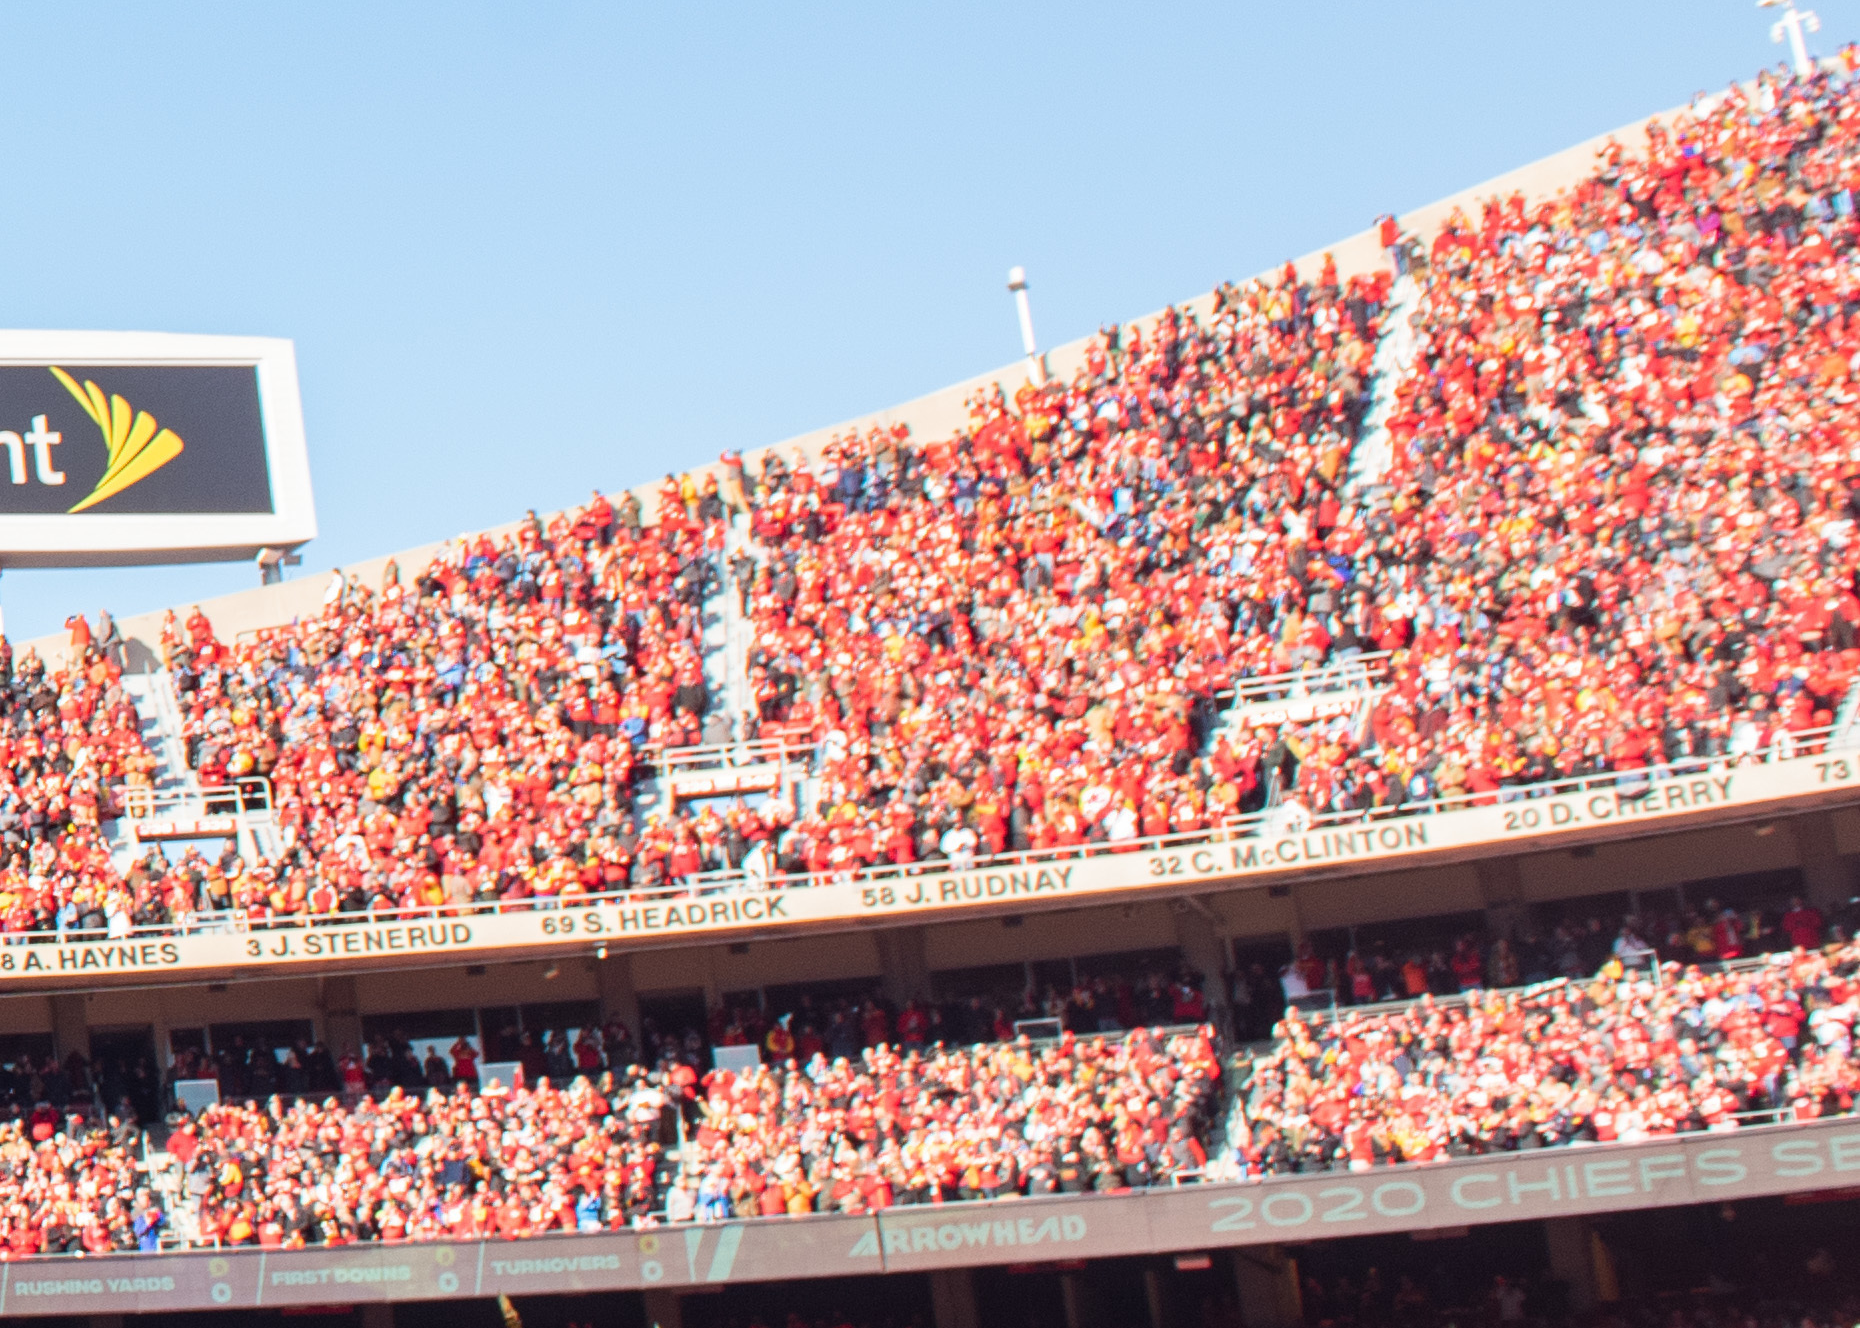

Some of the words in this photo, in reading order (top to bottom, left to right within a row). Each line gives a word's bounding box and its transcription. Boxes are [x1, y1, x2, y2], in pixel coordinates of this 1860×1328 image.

[1815, 760, 1849, 783] 73
[1504, 807, 1542, 831] 20
[1550, 799, 1583, 827] D.
[1587, 777, 1735, 822] CHERRY
[1150, 856, 1185, 876] 32
[1191, 849, 1223, 875] C.
[1231, 822, 1428, 869] McCLINTON
[863, 887, 896, 908] 58
[905, 880, 932, 904] J.
[940, 866, 1073, 902] RUDNAY
[541, 915, 576, 935] 69
[583, 910, 612, 934] S.
[620, 895, 788, 933] HEADRICK
[247, 939, 262, 957] 3
[269, 935, 295, 957] J.
[304, 923, 473, 956] STENERUD
[21, 949, 51, 971] A.
[58, 941, 179, 970] HAYNES
[1208, 1181, 1426, 1232] 2020
[1451, 1147, 1748, 1212] CHIEFS
[639, 1234, 659, 1254] 0
[849, 1214, 1087, 1258] ARROWHEAD
[209, 1257, 229, 1277] 0
[435, 1246, 455, 1266] 0
[491, 1254, 620, 1276] TURNOVERS
[272, 1268, 330, 1286] FIRST
[333, 1265, 411, 1285] DOWNS
[437, 1271, 459, 1293] 0
[641, 1259, 663, 1282] 0
[15, 1278, 104, 1297] RUSHING
[108, 1276, 175, 1294] YARDS
[210, 1282, 232, 1304] 0
